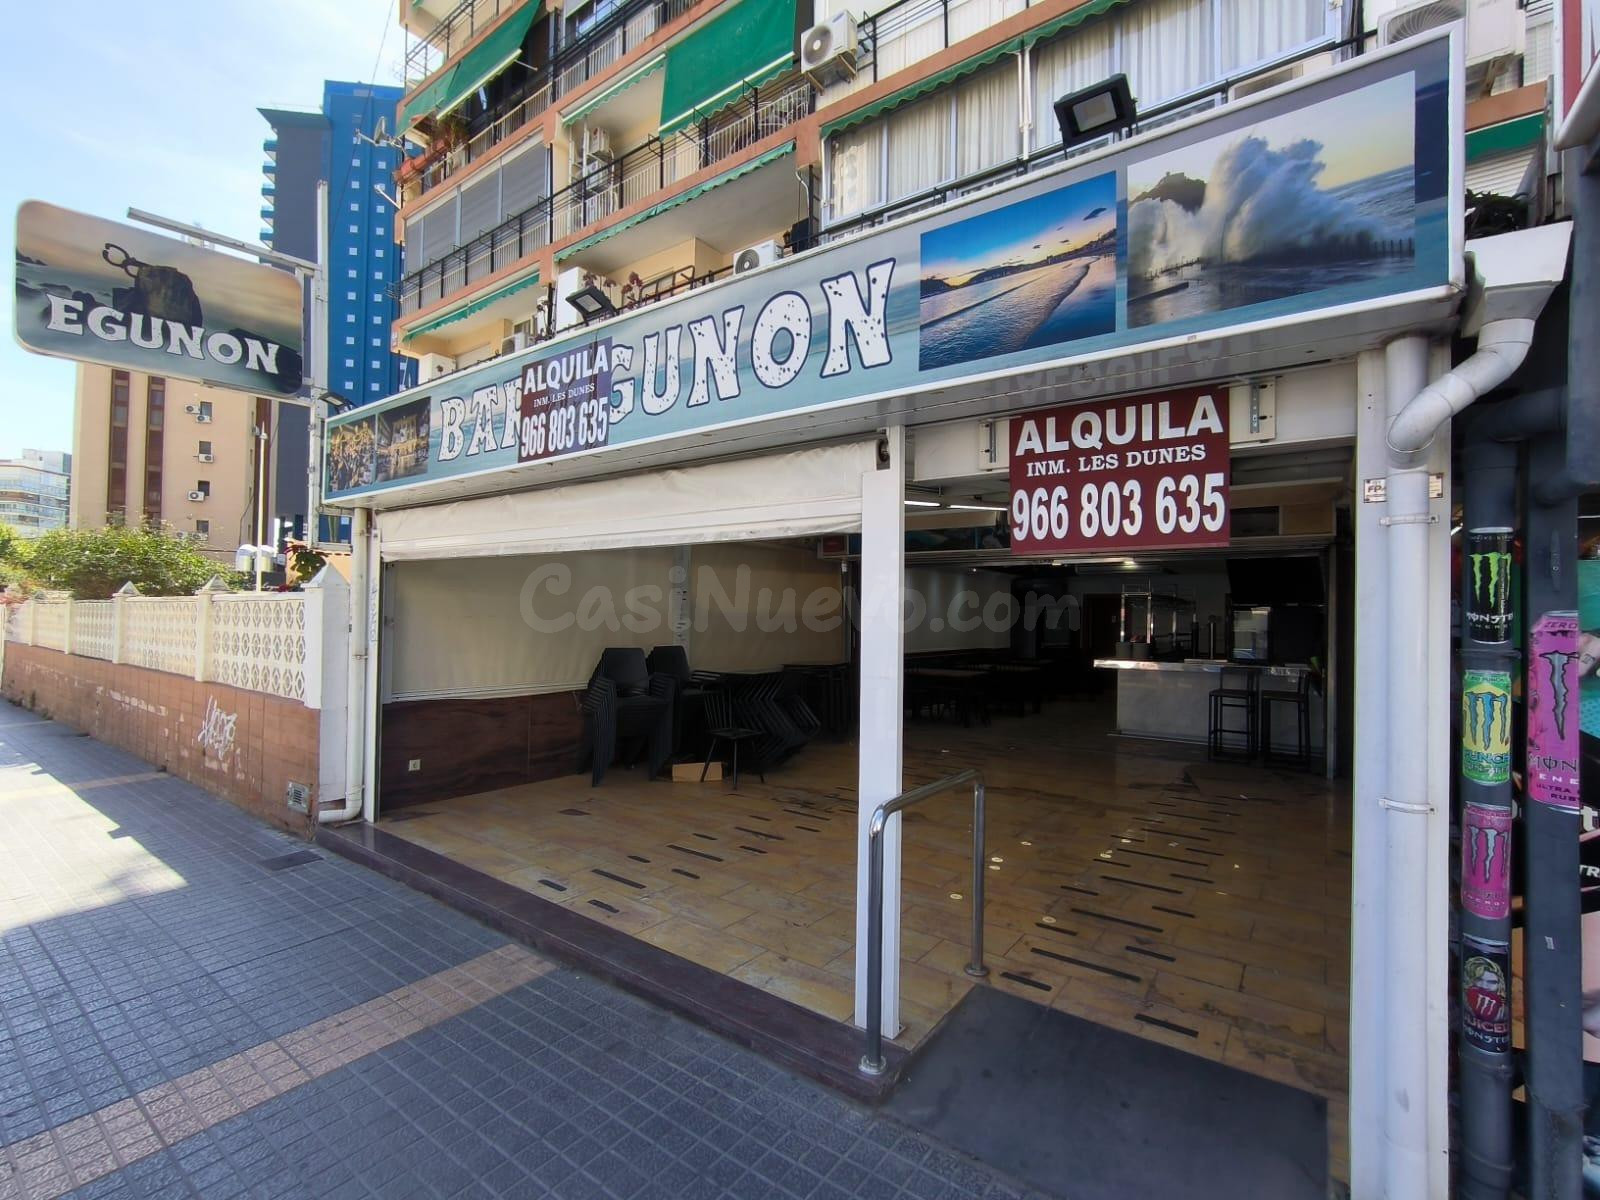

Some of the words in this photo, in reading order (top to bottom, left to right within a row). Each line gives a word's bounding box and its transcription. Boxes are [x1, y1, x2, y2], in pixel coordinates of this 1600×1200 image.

[46, 293, 280, 375] EGUNON
[609, 257, 897, 425] GUNON
[524, 345, 609, 395] ALQUILA
[534, 395, 550, 408] INM.
[551, 391, 566, 403] LES
[568, 383, 596, 399] DUNES
[521, 412, 546, 458] 966
[548, 405, 575, 453] 803
[578, 396, 609, 446] 635
[1015, 394, 1224, 457] ALQUILA
[1026, 460, 1071, 478] INM.
[1079, 453, 1120, 473] LES
[1126, 444, 1207, 468] DUNES
[1012, 485, 1070, 542] 966
[1080, 479, 1143, 538] 803
[1155, 472, 1225, 535] 635
